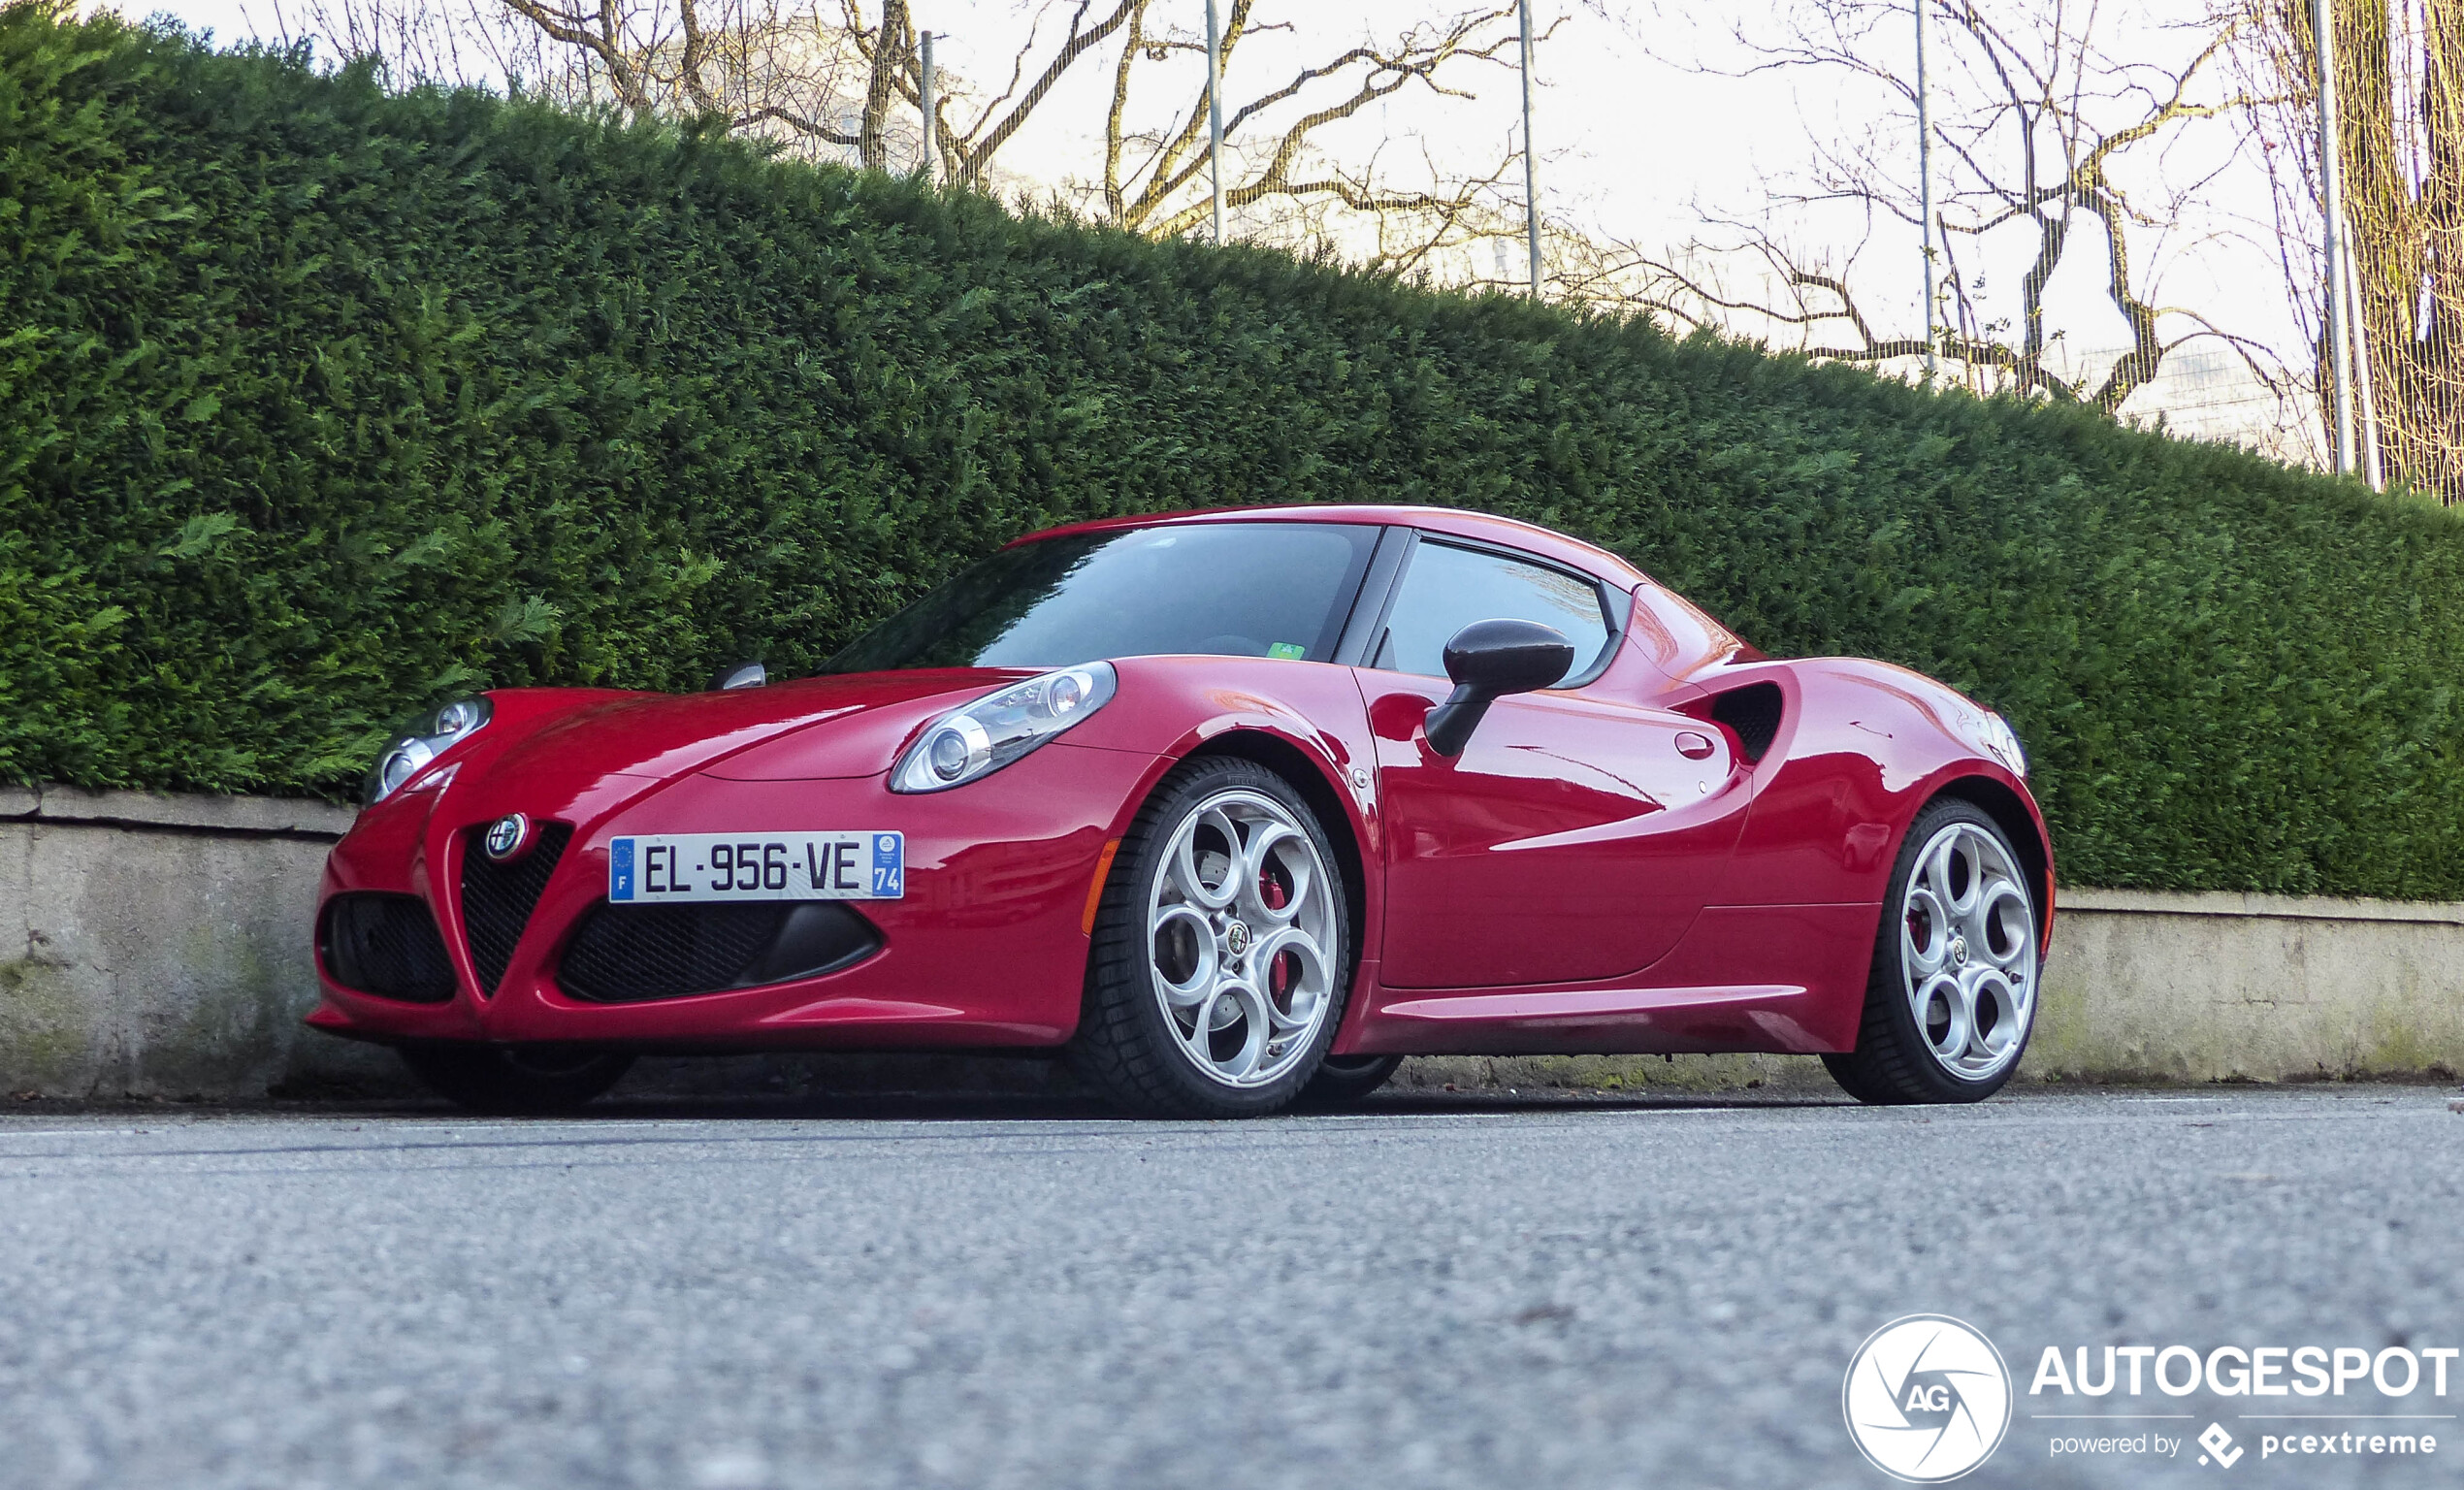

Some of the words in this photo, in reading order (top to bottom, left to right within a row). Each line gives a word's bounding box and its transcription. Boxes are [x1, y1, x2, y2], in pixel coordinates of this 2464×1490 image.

[645, 842, 859, 892] EL-956-VE
[874, 867, 900, 891] 74
[618, 875, 628, 891] F
